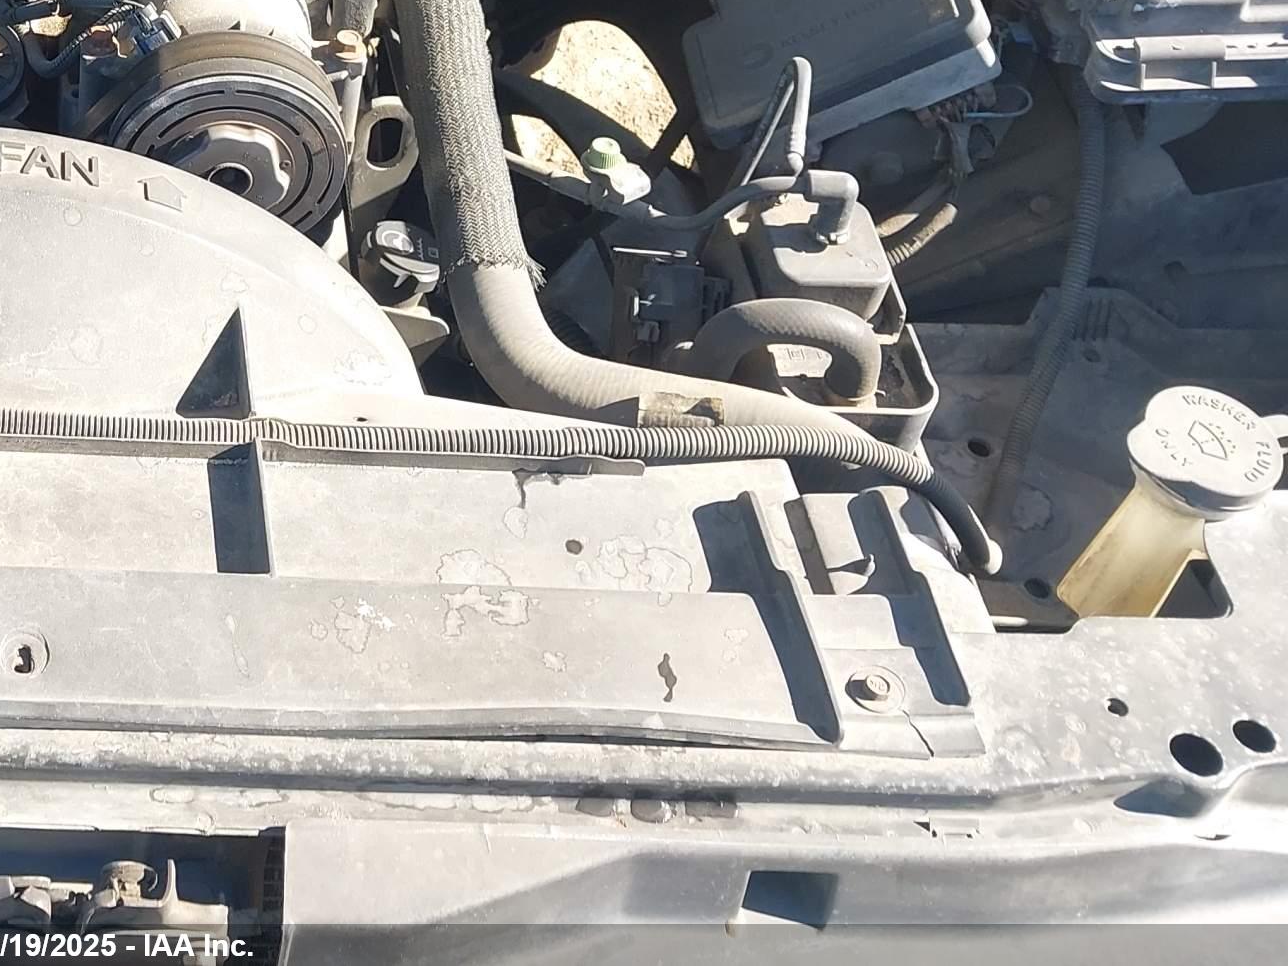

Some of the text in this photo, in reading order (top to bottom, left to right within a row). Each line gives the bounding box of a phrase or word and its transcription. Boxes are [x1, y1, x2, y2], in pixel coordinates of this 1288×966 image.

[1155, 395, 1272, 482] WASHER FLUID ONLY
